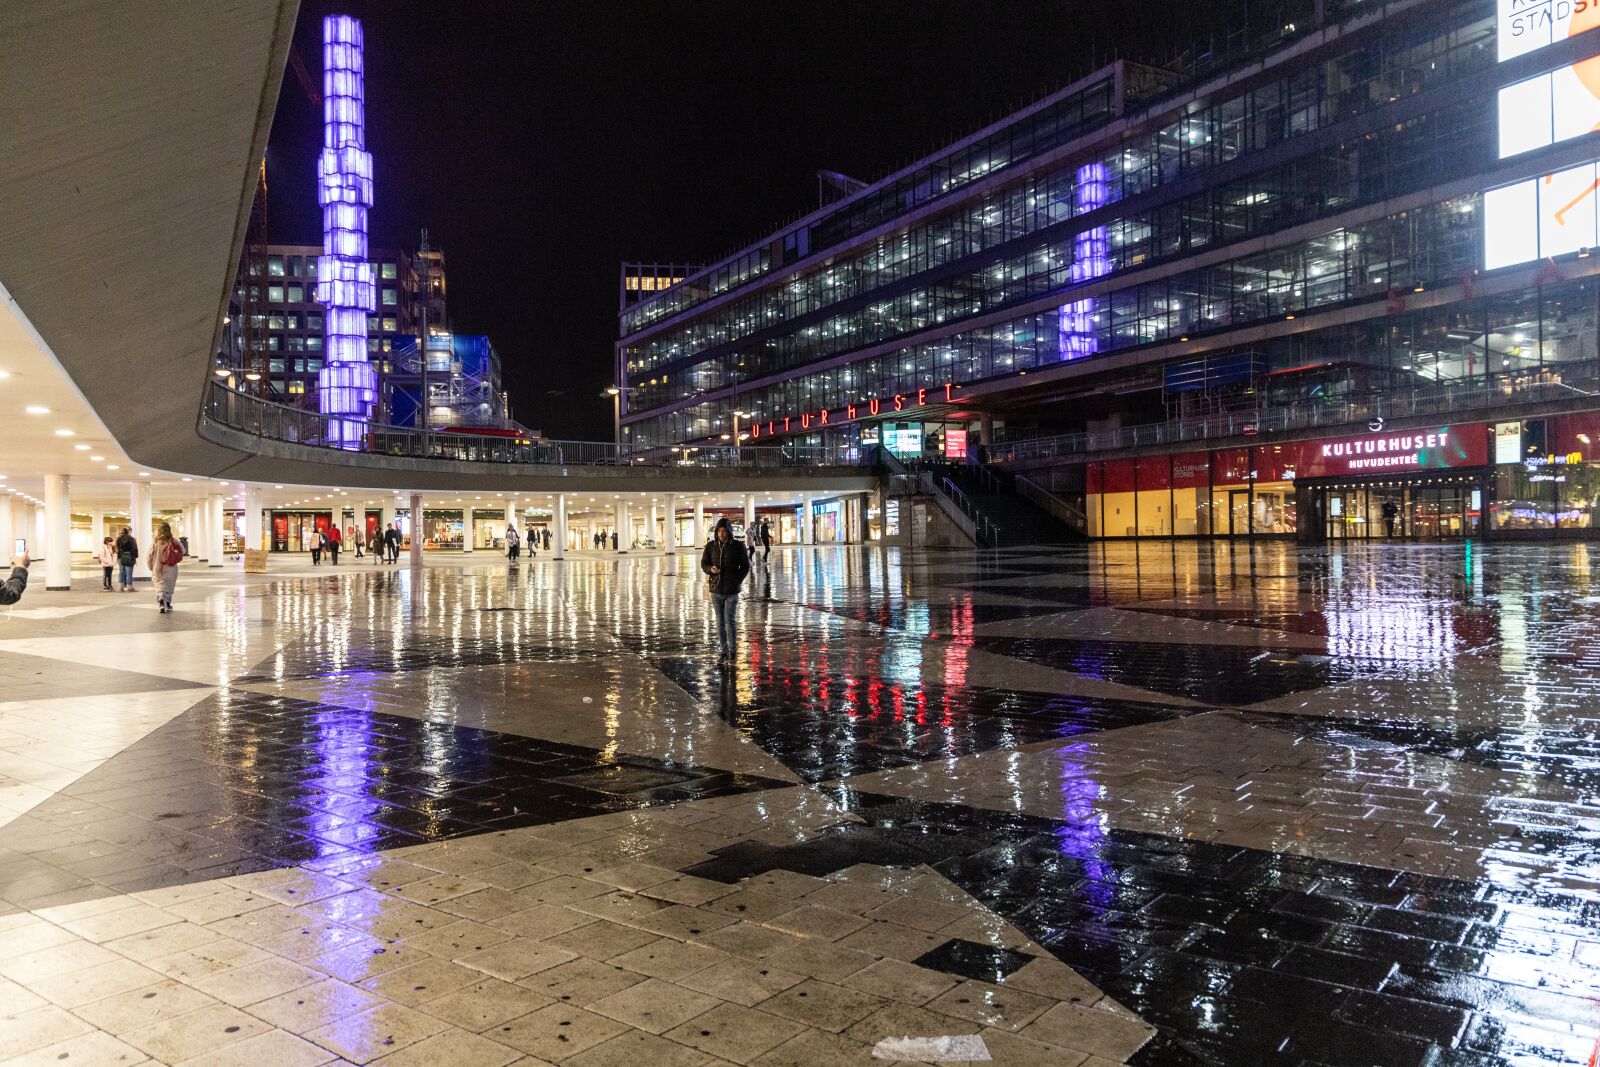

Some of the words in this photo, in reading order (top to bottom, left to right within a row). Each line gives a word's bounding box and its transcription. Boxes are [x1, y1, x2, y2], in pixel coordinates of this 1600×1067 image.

[739, 383, 951, 438] ULTURHUSET
[1322, 433, 1448, 457] KULTURHUSET
[1348, 453, 1418, 469] HUVUDENTRÉ
